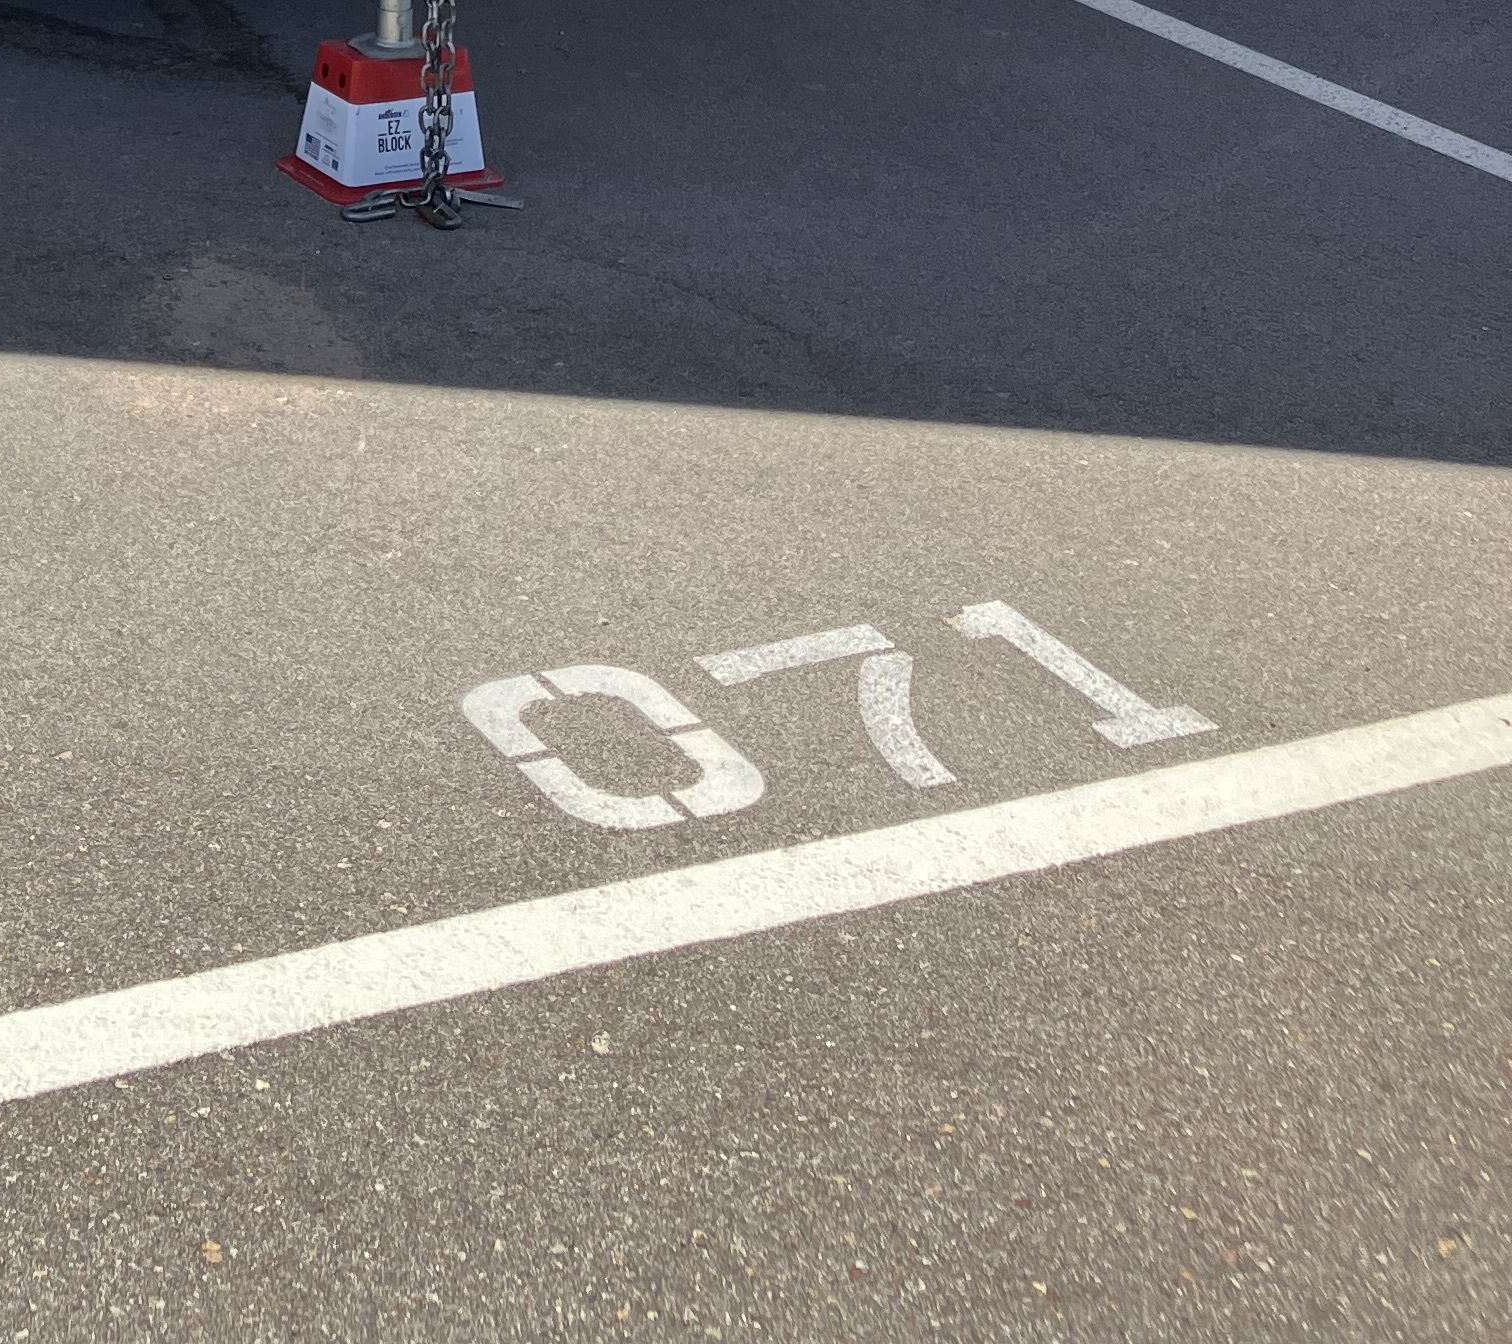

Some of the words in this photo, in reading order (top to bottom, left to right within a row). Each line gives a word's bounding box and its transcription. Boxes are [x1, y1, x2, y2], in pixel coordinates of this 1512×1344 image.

[388, 120, 401, 136] EZ
[378, 135, 412, 154] BLOCK
[461, 599, 1221, 831] 071
